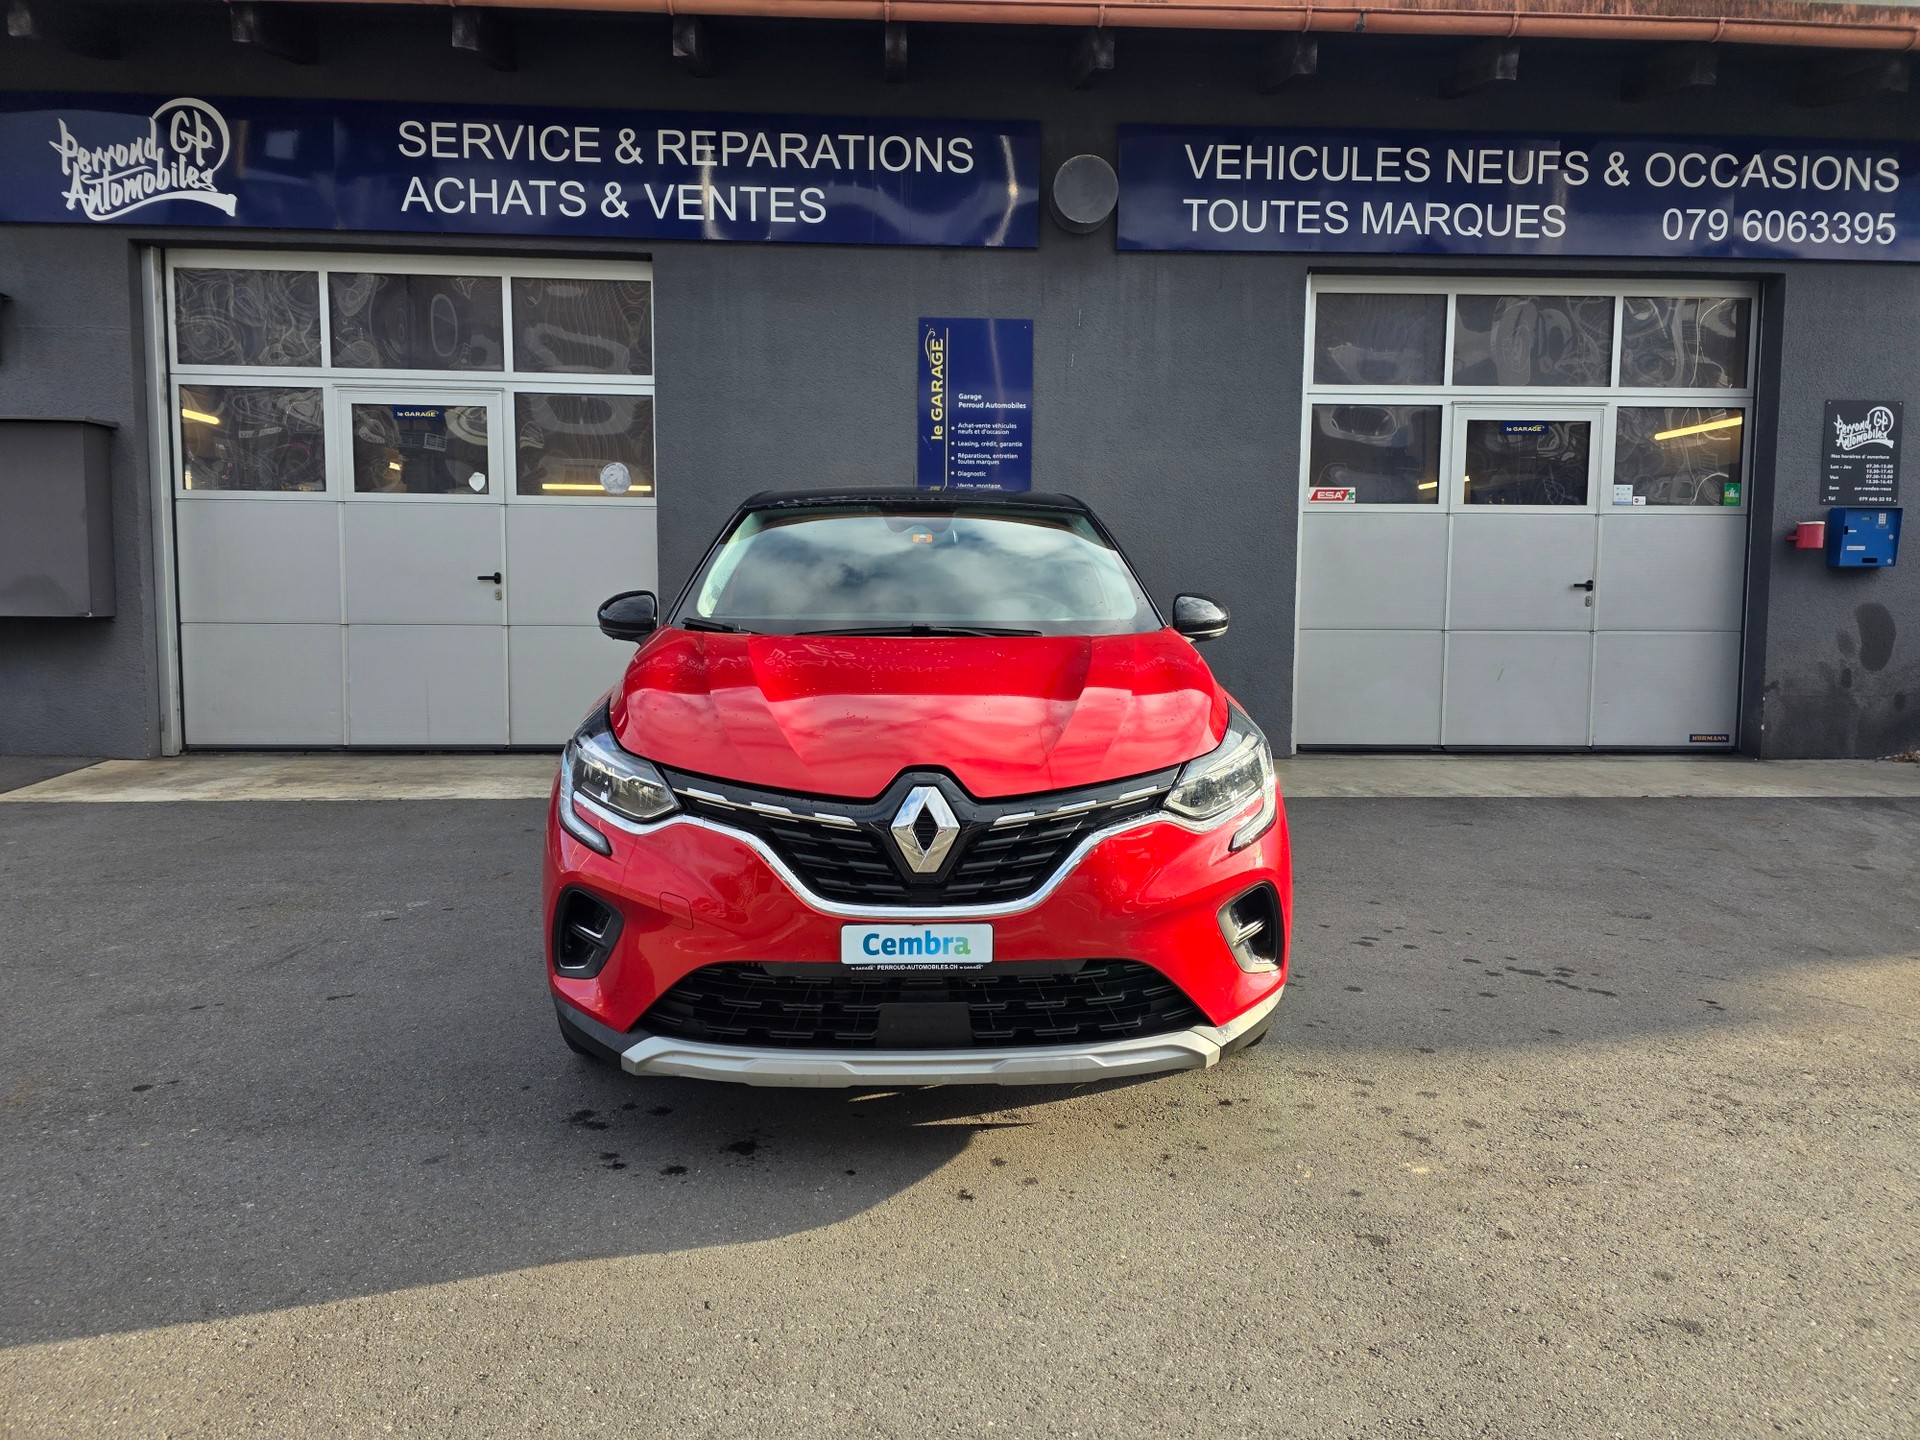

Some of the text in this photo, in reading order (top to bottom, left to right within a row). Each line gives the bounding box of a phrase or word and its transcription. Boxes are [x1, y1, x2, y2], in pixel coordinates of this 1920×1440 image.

[398, 121, 974, 174] SERVICE & REPARATIONS
[1184, 144, 1900, 193] VEHICULES NEUFS & OCCASIONS
[401, 176, 827, 224] ACHATS & VENTES
[1183, 198, 1567, 239] TOUTES MARQUES
[1662, 208, 1896, 245] 079 6063395
[930, 338, 944, 440] le GARAGE
[958, 393, 982, 401] Garage
[957, 452, 992, 460] Réparations,
[1317, 491, 1343, 500] ESA
[863, 930, 971, 956] Cembra
